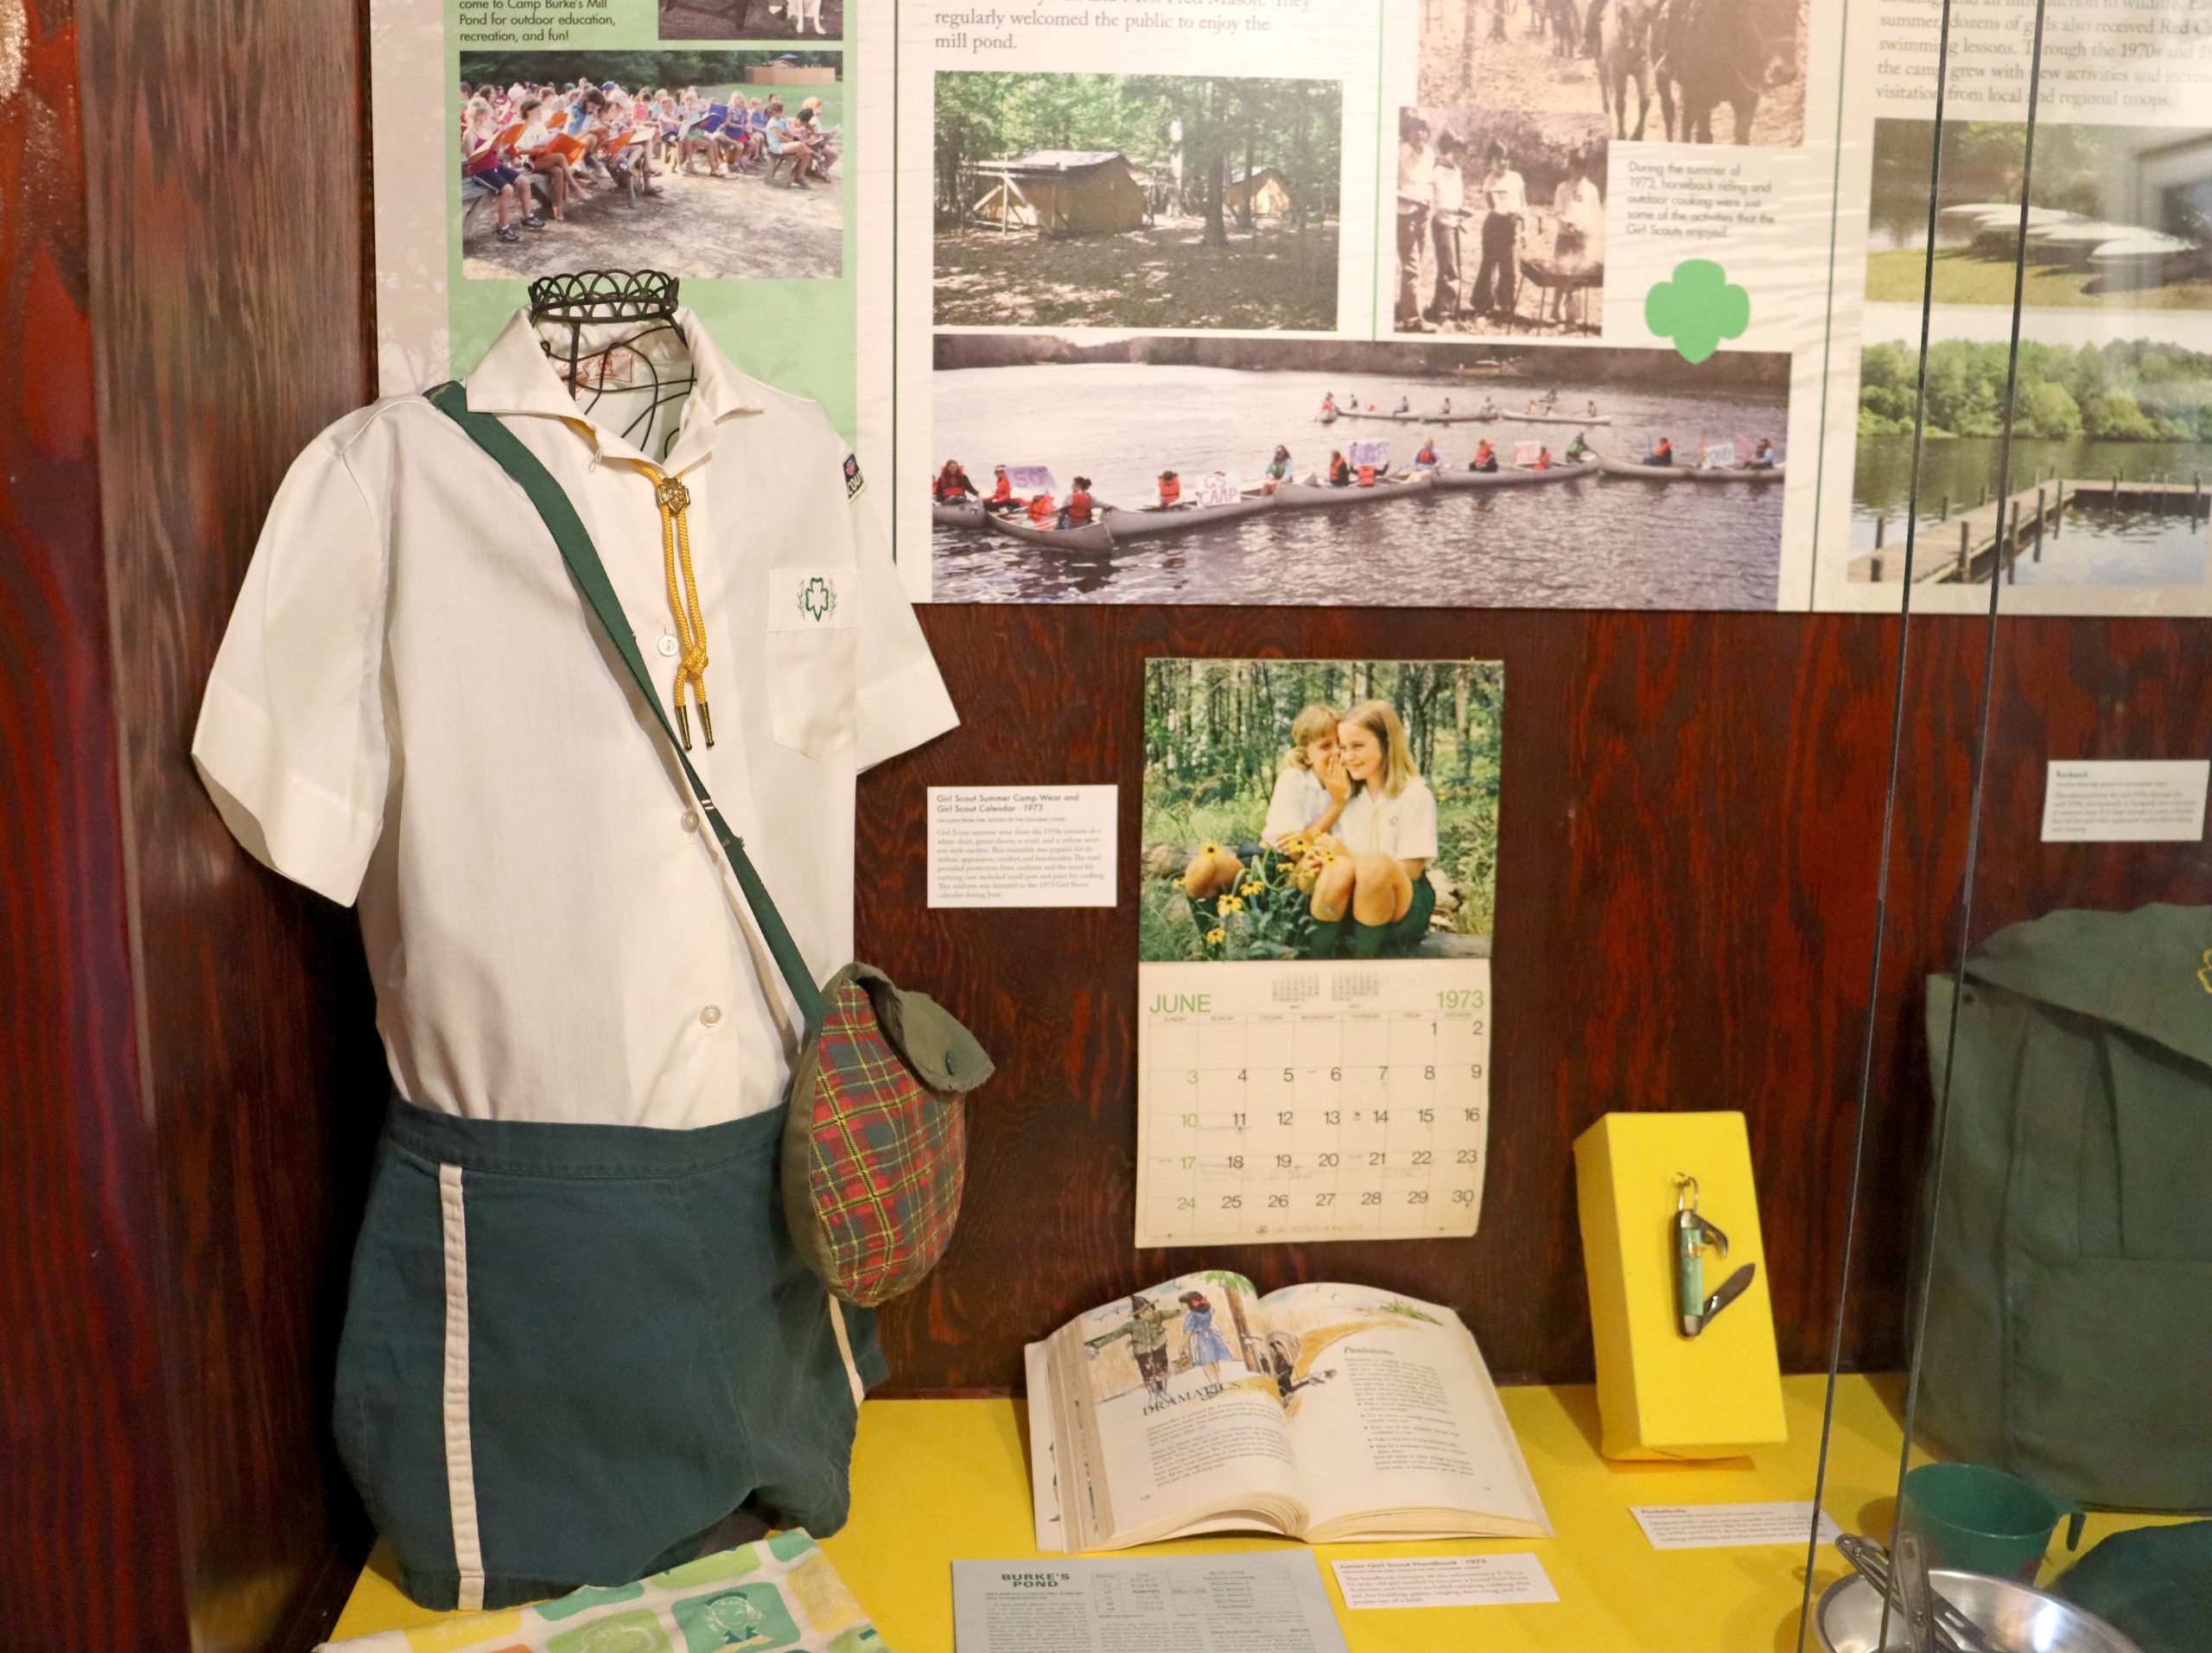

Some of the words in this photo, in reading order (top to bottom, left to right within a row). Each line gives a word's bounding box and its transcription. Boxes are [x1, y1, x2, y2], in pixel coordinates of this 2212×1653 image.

[460, 0, 489, 9] come
[493, 0, 503, 9] to
[507, 0, 541, 11] Camp
[545, 0, 583, 9] Burke's
[460, 13, 486, 25] Pond
[491, 12, 506, 25] for
[511, 13, 555, 25] outdoor
[558, 13, 615, 27] education,
[935, 8, 1006, 29] regularly
[1010, 9, 1089, 26] welcomed
[1096, 10, 1120, 26] the
[1125, 12, 1173, 33] public
[1179, 16, 1194, 29] to
[1198, 15, 1240, 35] enjoy
[1246, 15, 1270, 31] the
[1949, 12, 2000, 29] dozens
[2005, 14, 2024, 29] of
[2063, 16, 2092, 32] also
[2095, 17, 2155, 35] received
[460, 30, 518, 43] recreation,
[522, 29, 544, 41] and
[548, 28, 569, 41] fun!
[935, 32, 968, 48] mill
[973, 33, 1018, 54] pond.
[1878, 36, 1958, 58] swimmig
[1963, 36, 2017, 54] lessons.
[2021, 39, 2087, 61] Trough
[2091, 41, 2116, 57] the
[1877, 59, 1901, 75] the
[1949, 66, 1986, 81] grew
[1991, 63, 2024, 79] with
[2065, 66, 2129, 81] activities
[1946, 84, 1983, 101] from
[1988, 86, 2022, 103] local
[2059, 90, 2119, 109] regional
[1628, 161, 1664, 176] During
[1668, 162, 1683, 173] the
[1687, 166, 1726, 175] summer
[1730, 163, 1740, 176] of
[1661, 176, 1713, 190] horseback
[1718, 179, 1747, 195] riding
[1751, 180, 1771, 193] and
[1627, 193, 1668, 204] outdoor
[1672, 194, 1713, 209] cooking
[1744, 198, 1761, 209] just
[1657, 207, 1668, 219] of
[1671, 209, 1687, 220] the
[1690, 212, 1733, 223] activities
[1737, 211, 1756, 223] that
[1759, 211, 1775, 224] the
[1626, 223, 1647, 234] Girl
[1650, 224, 1682, 237] Scouts
[1199, 487, 1237, 506] CAMP
[978, 804, 1016, 812] Calendar
[1024, 804, 1044, 812] 1973
[979, 793, 1010, 802] Summer
[1013, 793, 1037, 804] Camp
[1039, 793, 1062, 802] Wear
[1063, 793, 1079, 802] and
[1150, 995, 1211, 1014] JUNE
[1438, 990, 1484, 1009] 1973
[1473, 1020, 1483, 1035] 2
[1188, 1070, 1198, 1084] 3
[1238, 1069, 1247, 1082] 4
[1284, 1068, 1294, 1082] 5
[1332, 1067, 1341, 1081] 6
[1379, 1066, 1389, 1079] 7
[1425, 1065, 1435, 1079] 8
[1471, 1065, 1482, 1078] 9
[1182, 1114, 1198, 1127] 10
[1234, 1113, 1245, 1125] 11
[1278, 1112, 1293, 1125] 12
[1325, 1111, 1340, 1124] 13
[1374, 1110, 1388, 1122] 14
[1419, 1109, 1433, 1122] 15
[1465, 1108, 1479, 1121] 16
[1182, 1156, 1196, 1169] 17
[1229, 1155, 1243, 1168] 18
[1277, 1154, 1291, 1167] 19
[1319, 1154, 1339, 1167] 20
[1370, 1152, 1385, 1165] 21
[1412, 1151, 1431, 1165] 22
[1457, 1150, 1477, 1163] 23
[1178, 1198, 1196, 1210] 24
[1222, 1196, 1242, 1208] 25
[1269, 1195, 1288, 1207] 26
[1316, 1193, 1336, 1206] 27
[1362, 1192, 1382, 1205] 28
[1408, 1192, 1428, 1204] 29
[1452, 1190, 1474, 1203] 30
[1001, 1573, 1070, 1581] BURKE'S
